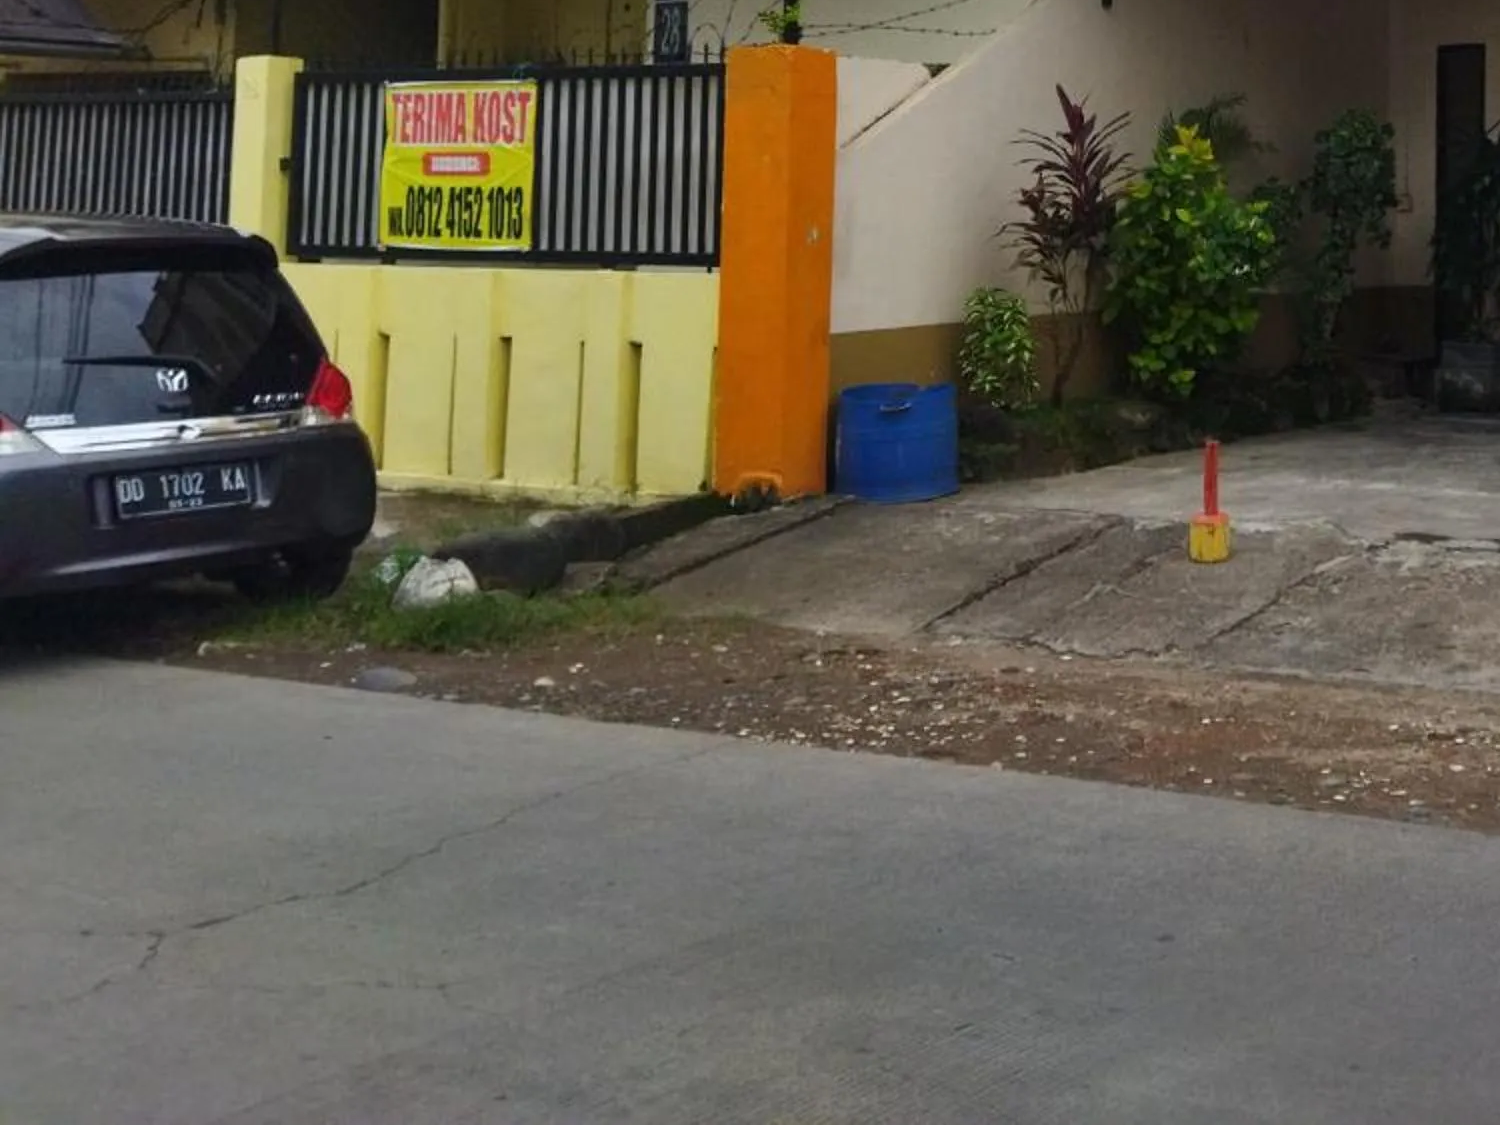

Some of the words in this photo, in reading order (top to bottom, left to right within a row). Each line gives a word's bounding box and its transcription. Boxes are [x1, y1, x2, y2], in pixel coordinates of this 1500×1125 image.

[392, 91, 467, 144] TERIMA
[473, 90, 532, 144] KOST
[406, 186, 442, 238] 0812
[446, 186, 482, 238] 4152
[487, 186, 523, 239] 1013
[119, 478, 145, 503] DD
[159, 472, 205, 499] 1702
[220, 466, 246, 491] KA
